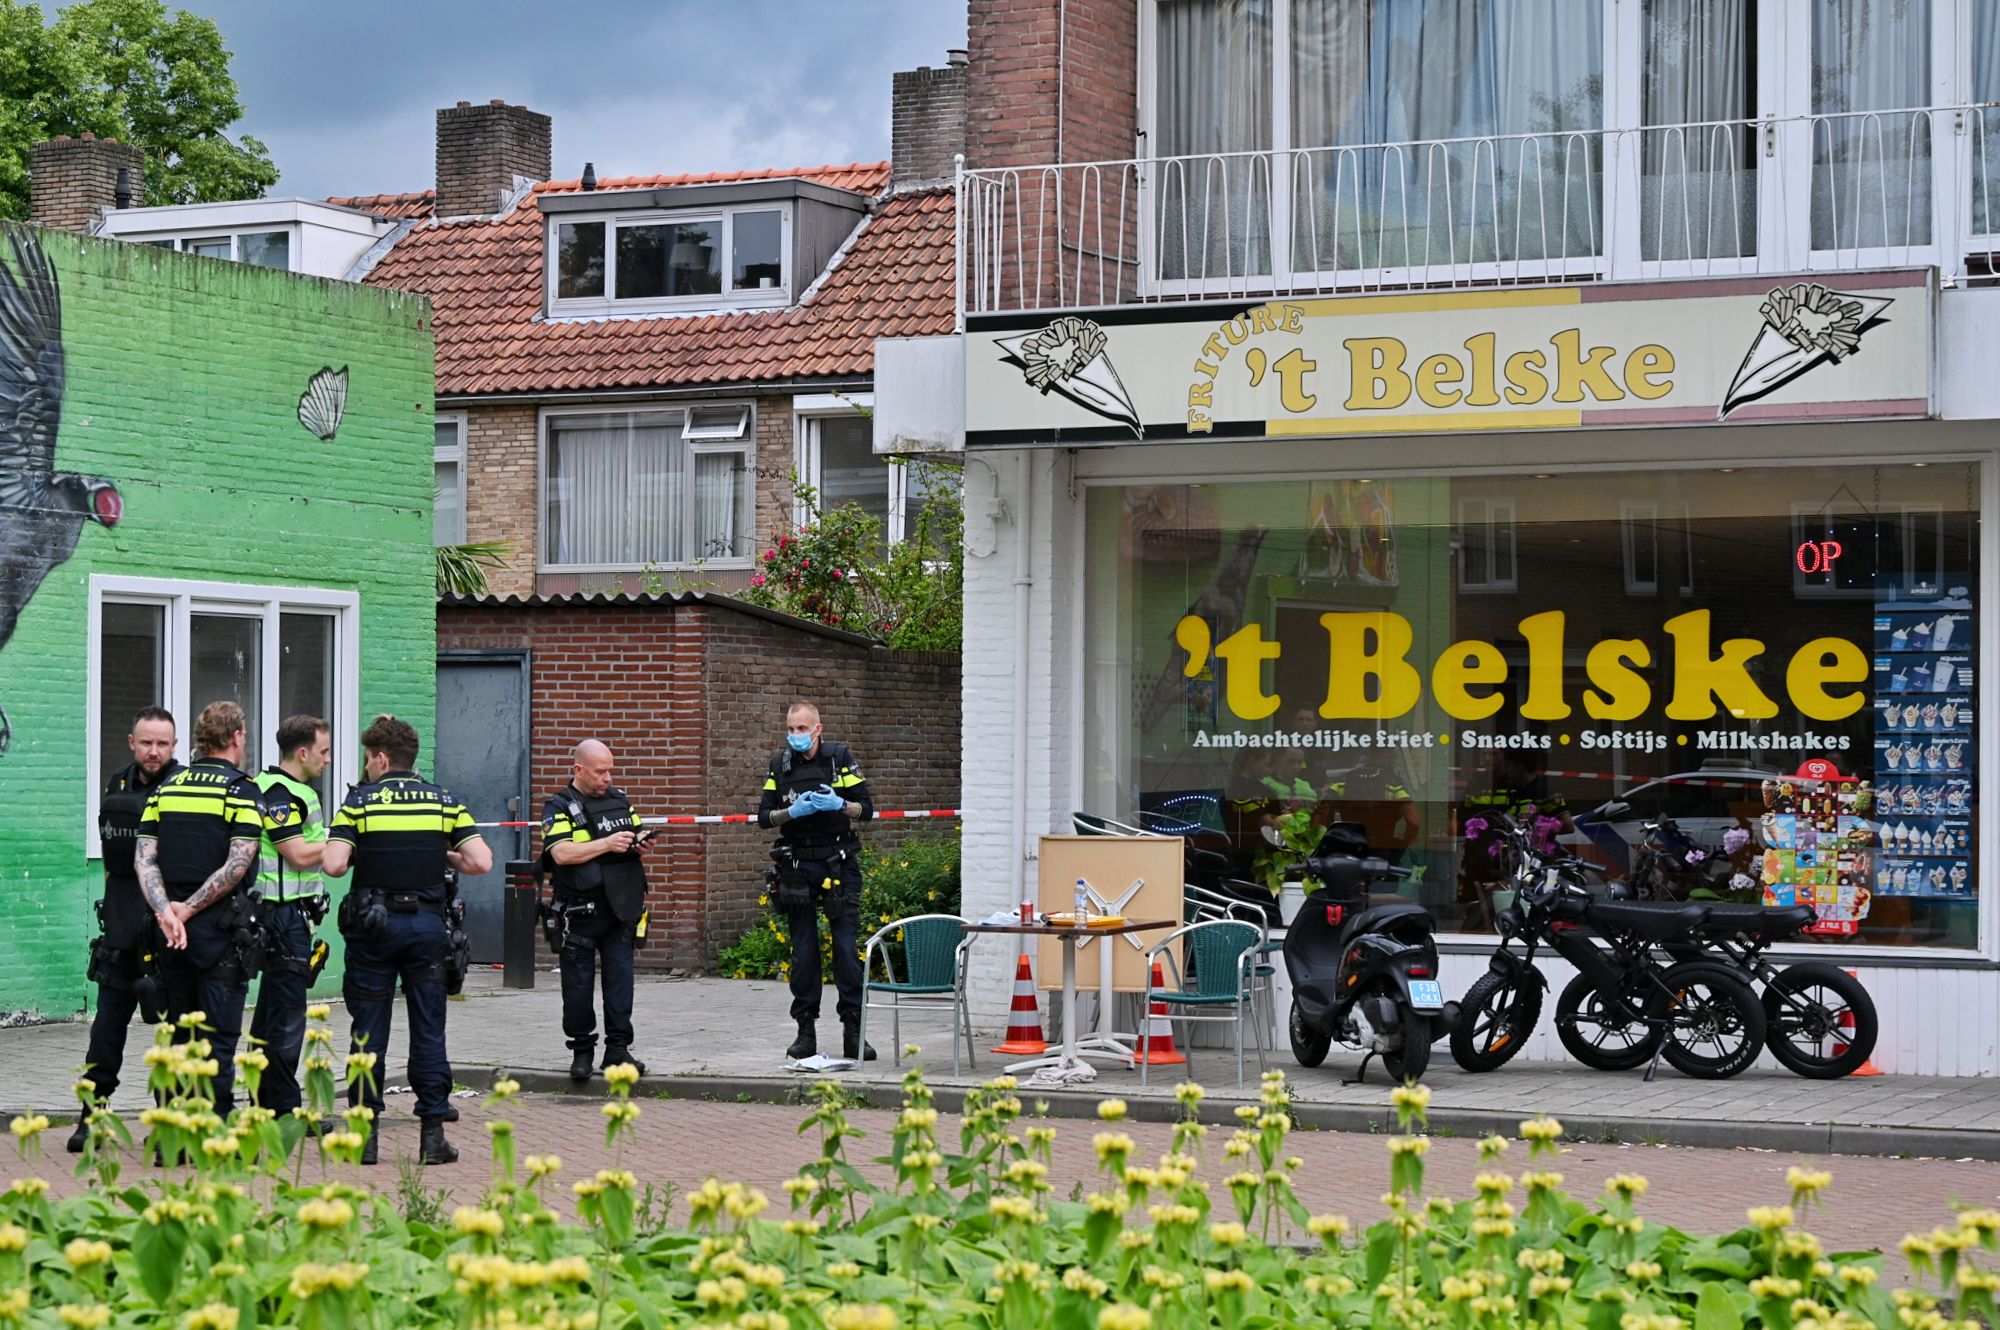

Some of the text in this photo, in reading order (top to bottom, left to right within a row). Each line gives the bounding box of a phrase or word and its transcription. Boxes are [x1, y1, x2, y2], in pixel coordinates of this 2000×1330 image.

[1186, 304, 1305, 434] FRITURE
[1343, 328, 1676, 411] Belske
[1796, 541, 1842, 574] OP
[1318, 609, 1869, 721] Belske
[1191, 730, 1851, 753] Ambachtelijke friet Snacks Softijs Milkshakes
[372, 786, 434, 804] POLITIE
